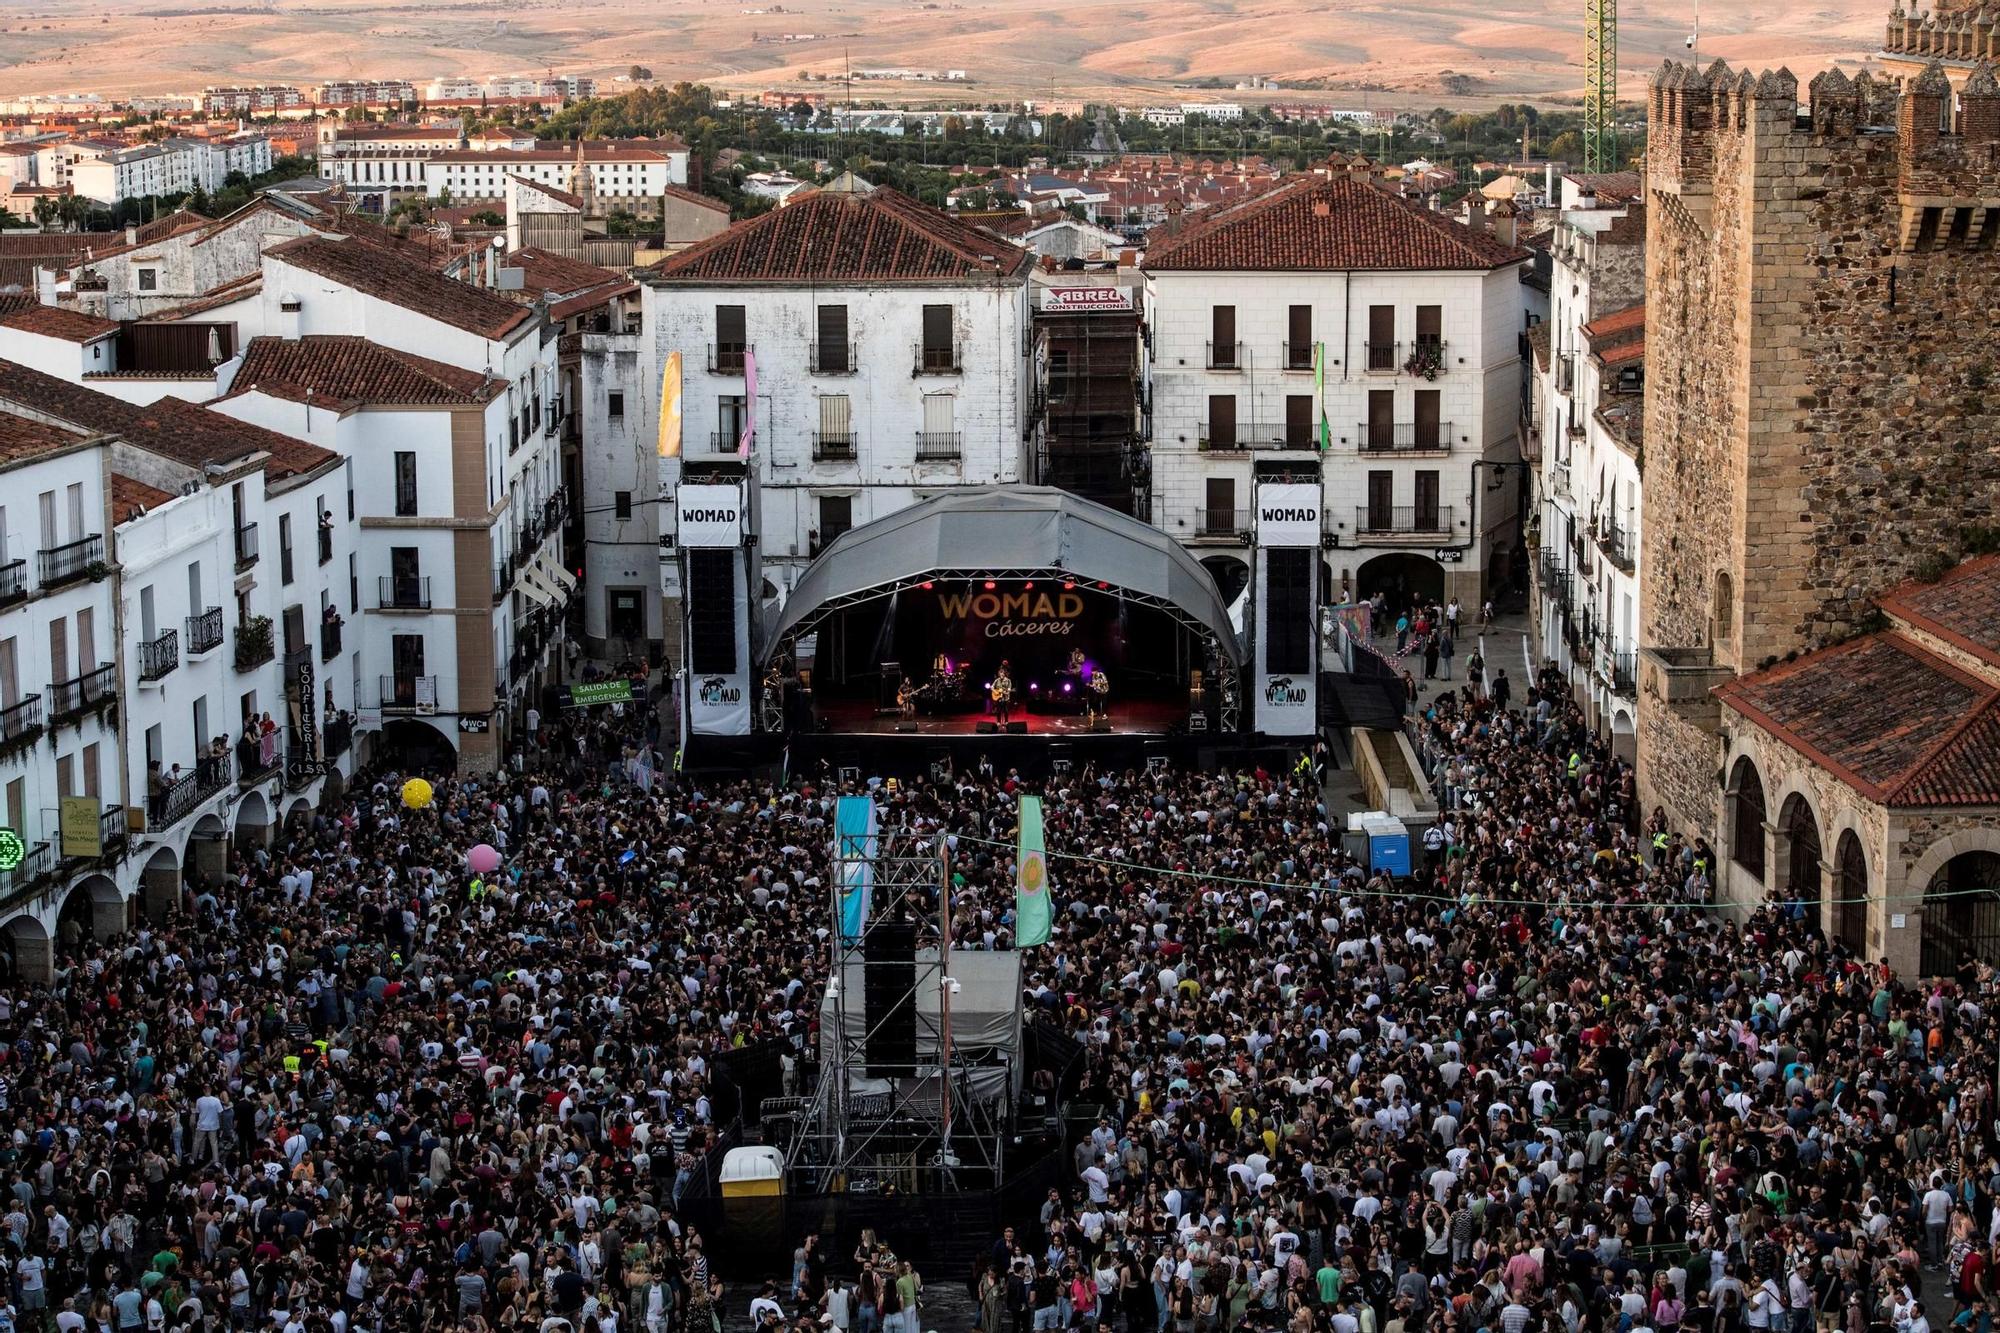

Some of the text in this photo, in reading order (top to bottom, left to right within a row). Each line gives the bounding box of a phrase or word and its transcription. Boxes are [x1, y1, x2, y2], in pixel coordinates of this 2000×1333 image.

[1058, 290, 1119, 301] ABREU
[682, 509, 736, 522] WOMAD
[1262, 508, 1316, 521] WOMAD
[938, 592, 1084, 619] WOMAD
[984, 619, 1074, 638] Cáceres
[579, 683, 609, 693] SALIDA
[609, 681, 621, 689] DE
[575, 691, 630, 704] EMERGENCIA
